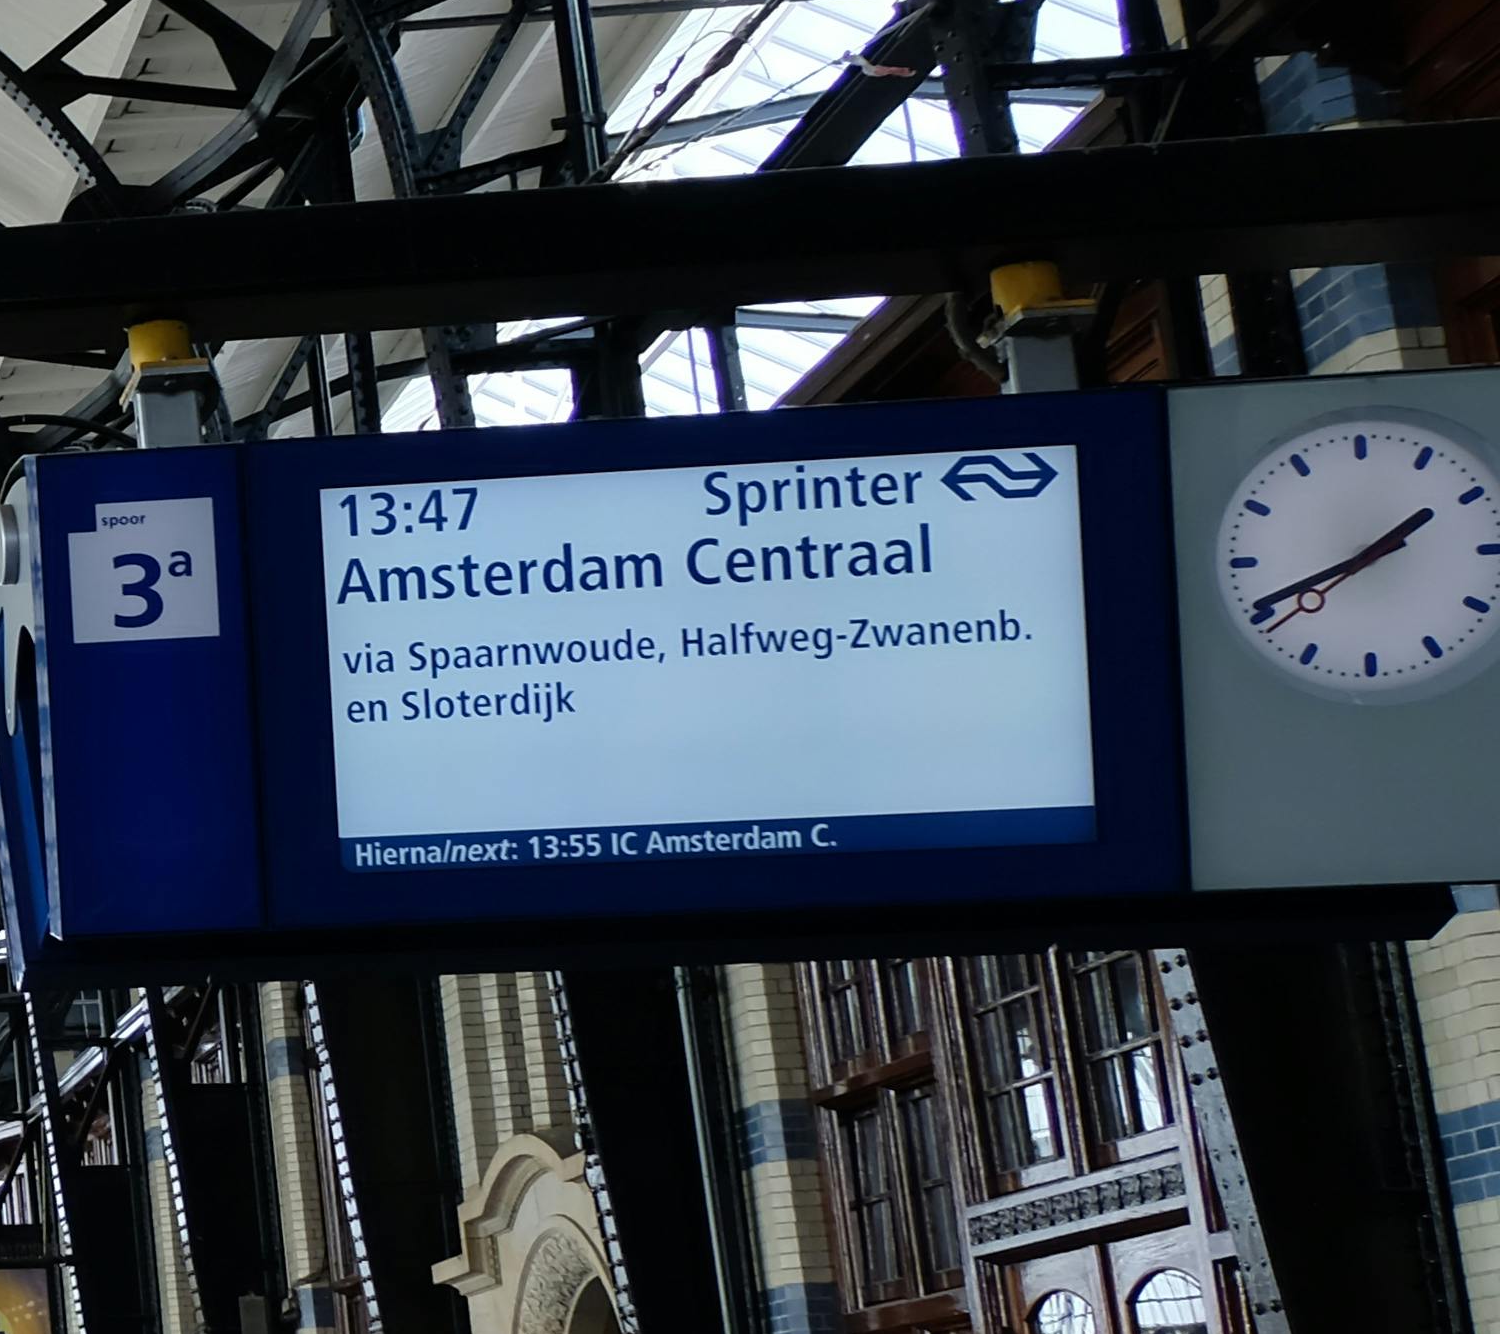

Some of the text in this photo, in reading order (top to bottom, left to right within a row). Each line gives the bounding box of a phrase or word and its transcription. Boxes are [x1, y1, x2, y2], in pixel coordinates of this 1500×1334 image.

[101, 515, 146, 527] spoor
[340, 465, 923, 537] 13:47 Sprinter
[337, 523, 932, 605] Amsterdam Centraal
[343, 610, 1032, 674] via Spaarnwoude, Halfweg-Zwanenb.
[348, 682, 576, 724] en Sloterdijk
[356, 824, 837, 867] Hierna/next: 13:55 IC Amsterdam C.
